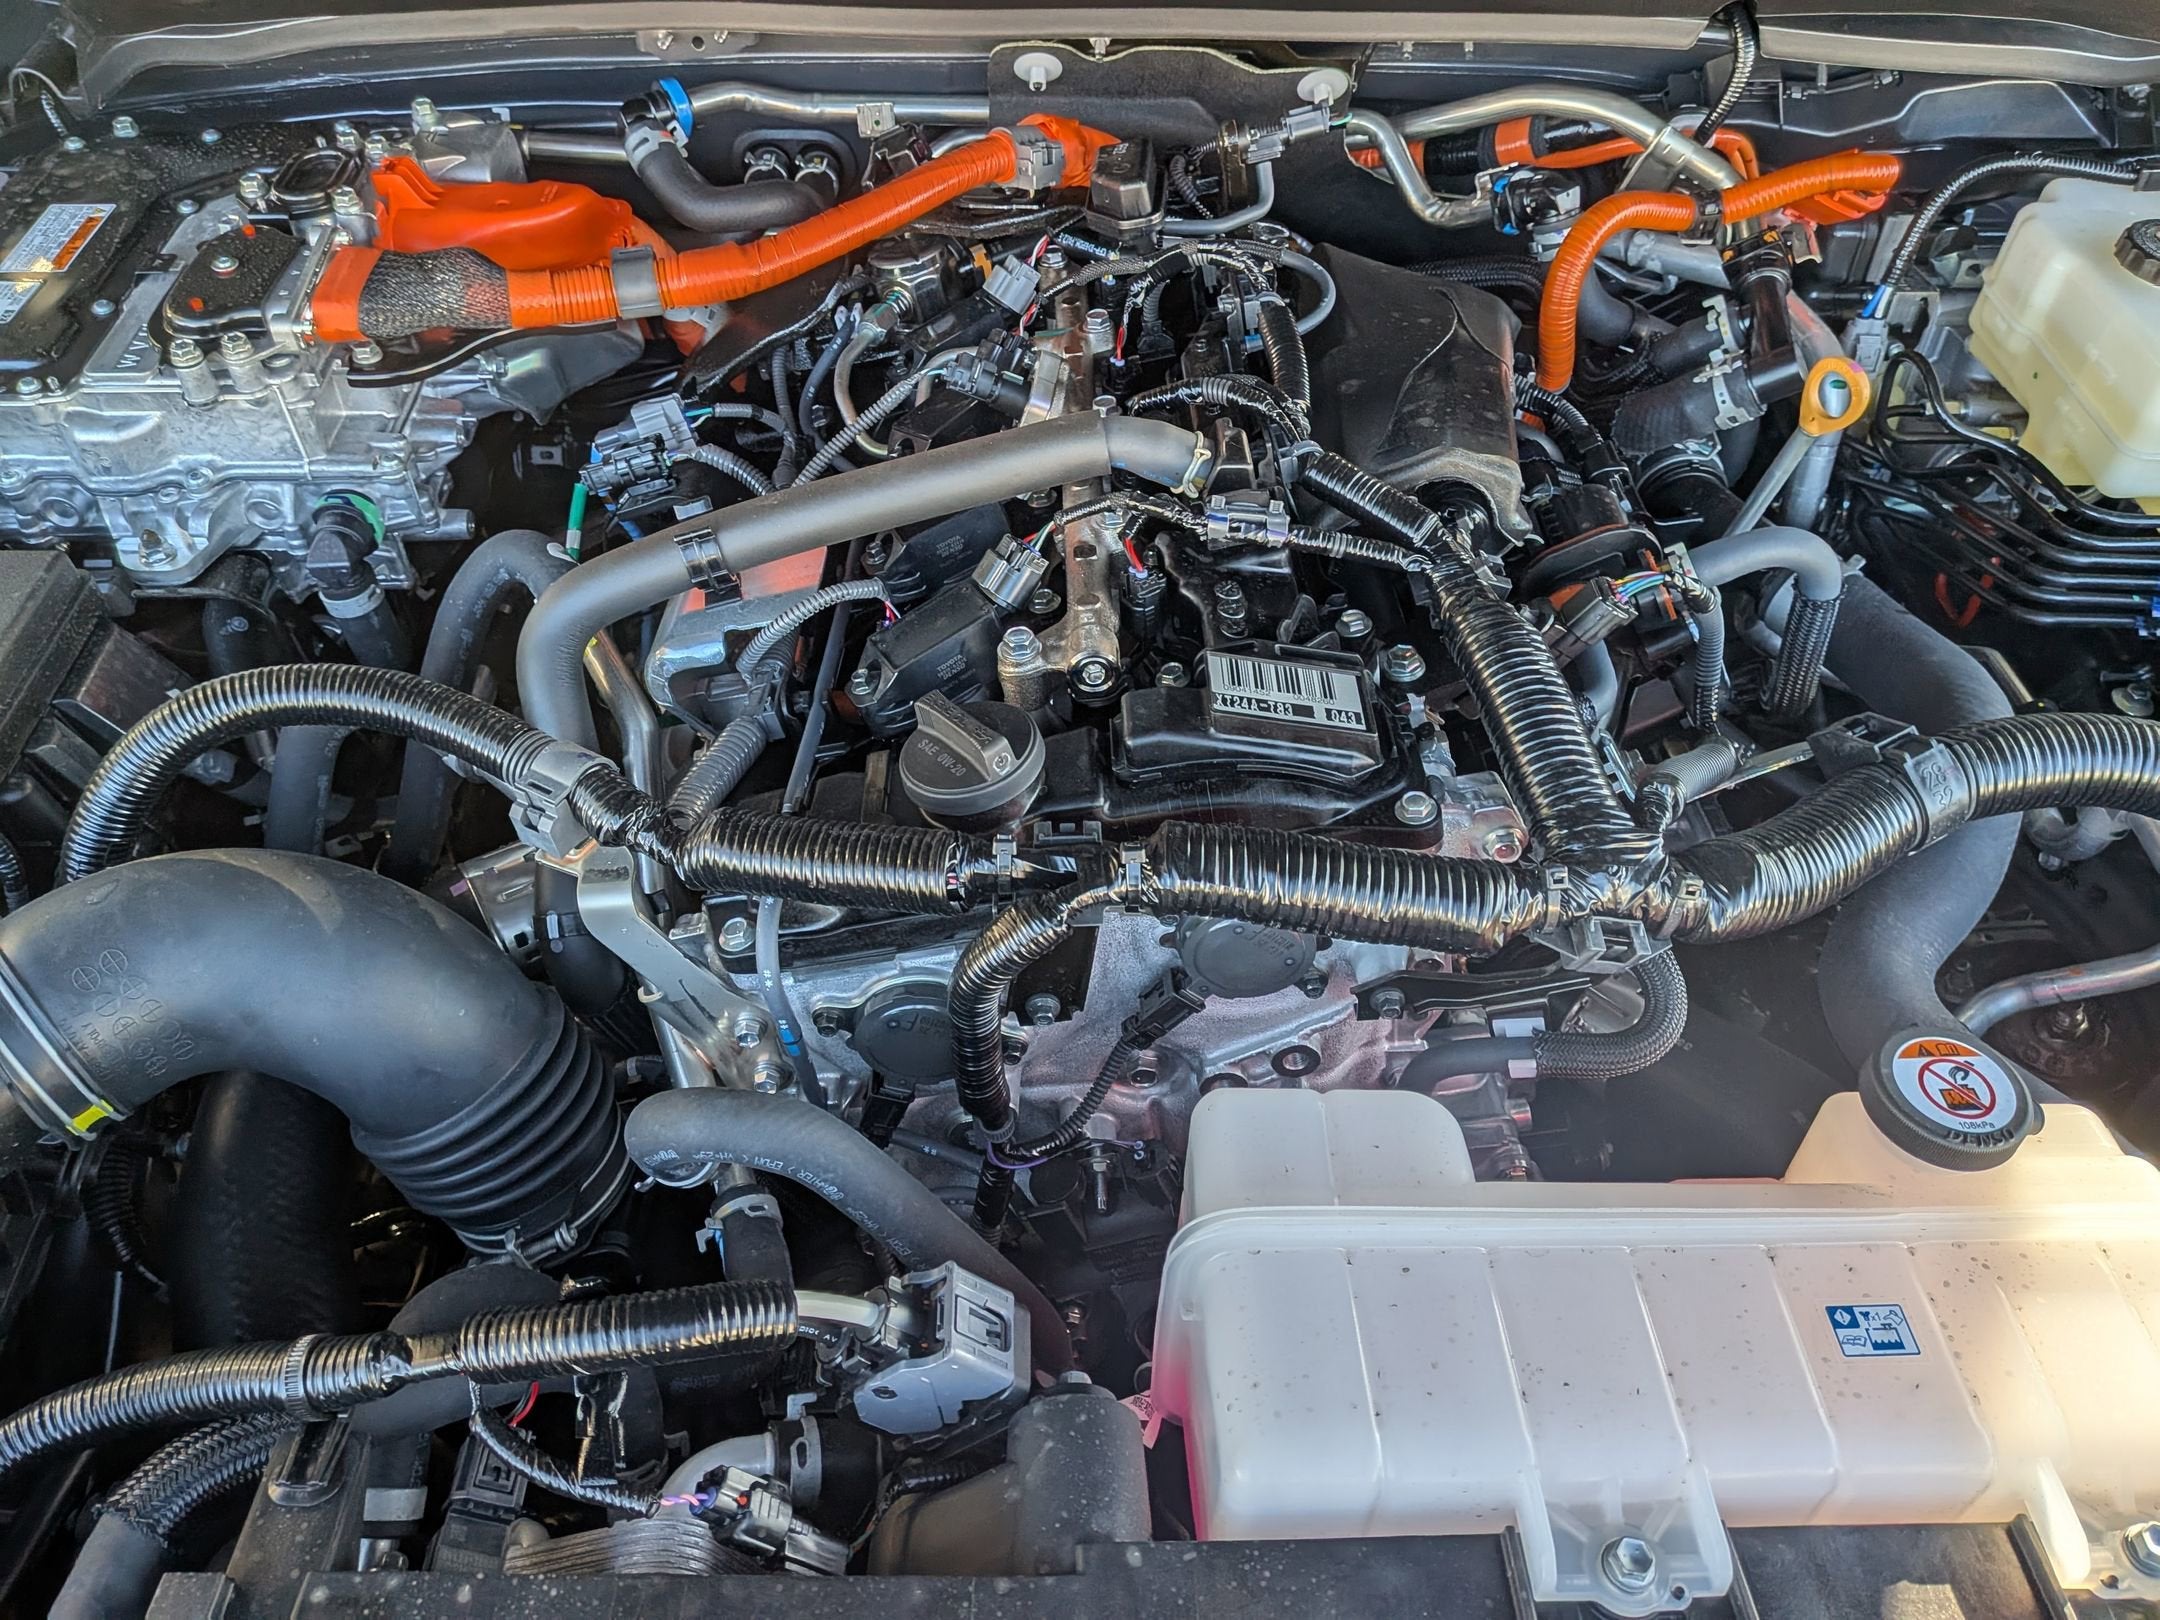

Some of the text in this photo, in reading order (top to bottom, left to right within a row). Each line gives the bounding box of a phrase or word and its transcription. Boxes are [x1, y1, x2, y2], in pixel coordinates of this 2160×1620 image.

[936, 654, 963, 672] TOYOTA
[942, 662, 966, 680] DENSO
[918, 739, 967, 777] SAE 0W-20
[1921, 762, 1947, 791] 28
[1932, 785, 1957, 815] 32
[1958, 1120, 1996, 1130] 108kPa
[1944, 1127, 2016, 1148] DENSO
[753, 1156, 784, 1171] EPDM
